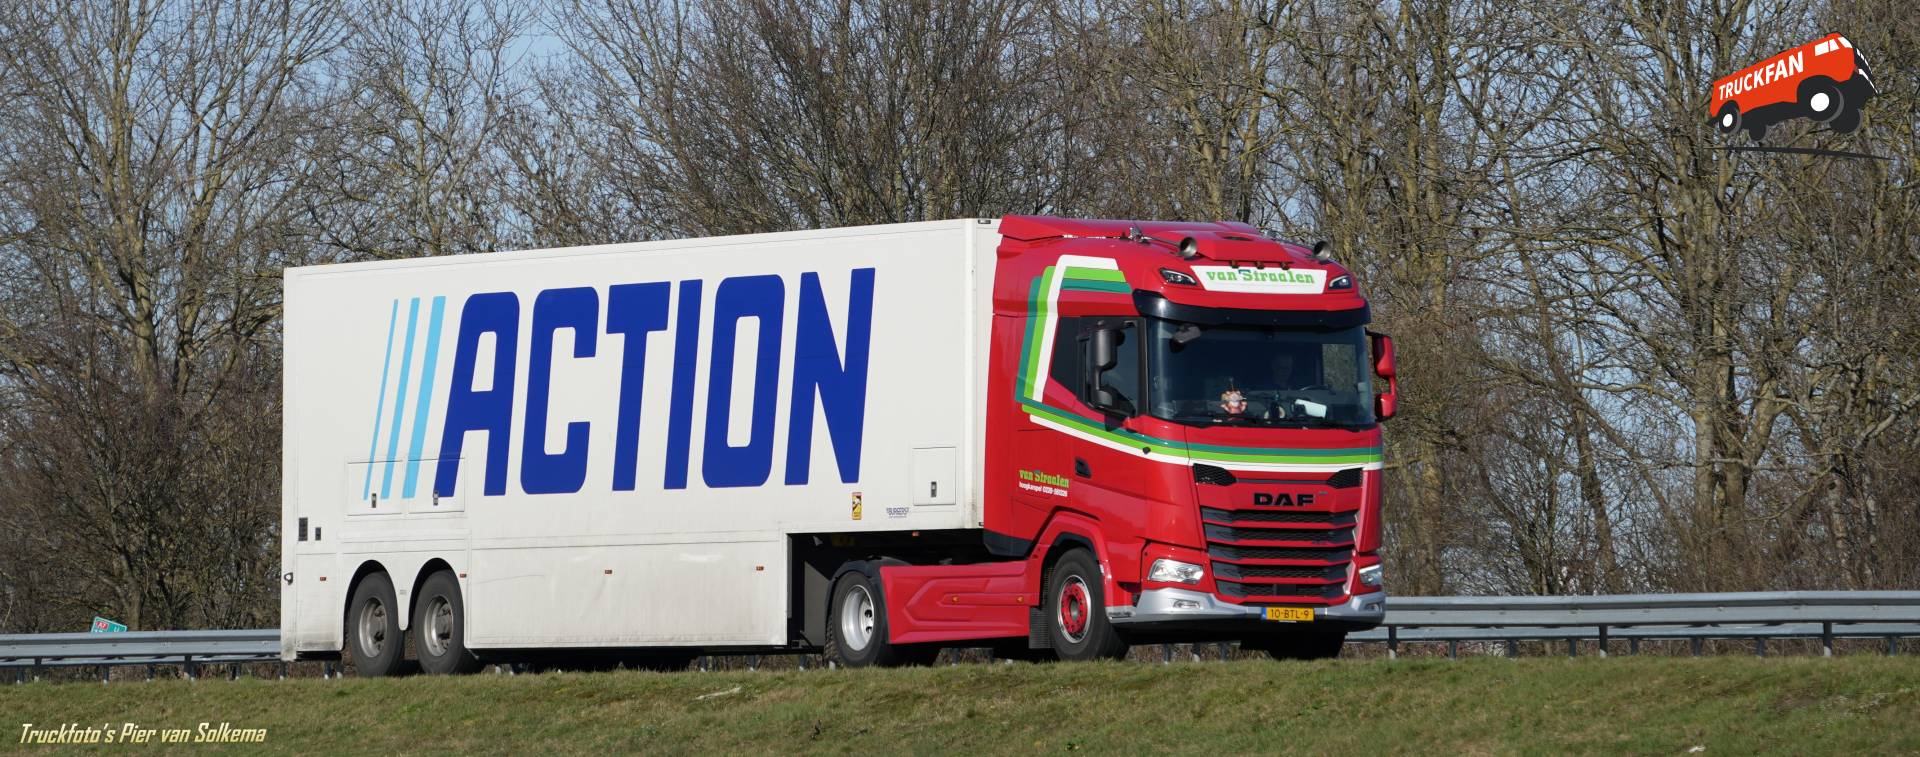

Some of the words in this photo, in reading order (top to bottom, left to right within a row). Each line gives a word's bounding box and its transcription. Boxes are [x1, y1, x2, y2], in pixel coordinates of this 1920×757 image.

[1206, 271, 1237, 281] van
[1238, 269, 1315, 284] Straalen
[433, 267, 876, 498] ACTION
[1019, 469, 1033, 480] van
[1034, 470, 1069, 488] Straalen
[1254, 493, 1314, 506] DAF
[1271, 609, 1310, 619] 10-BTL-9
